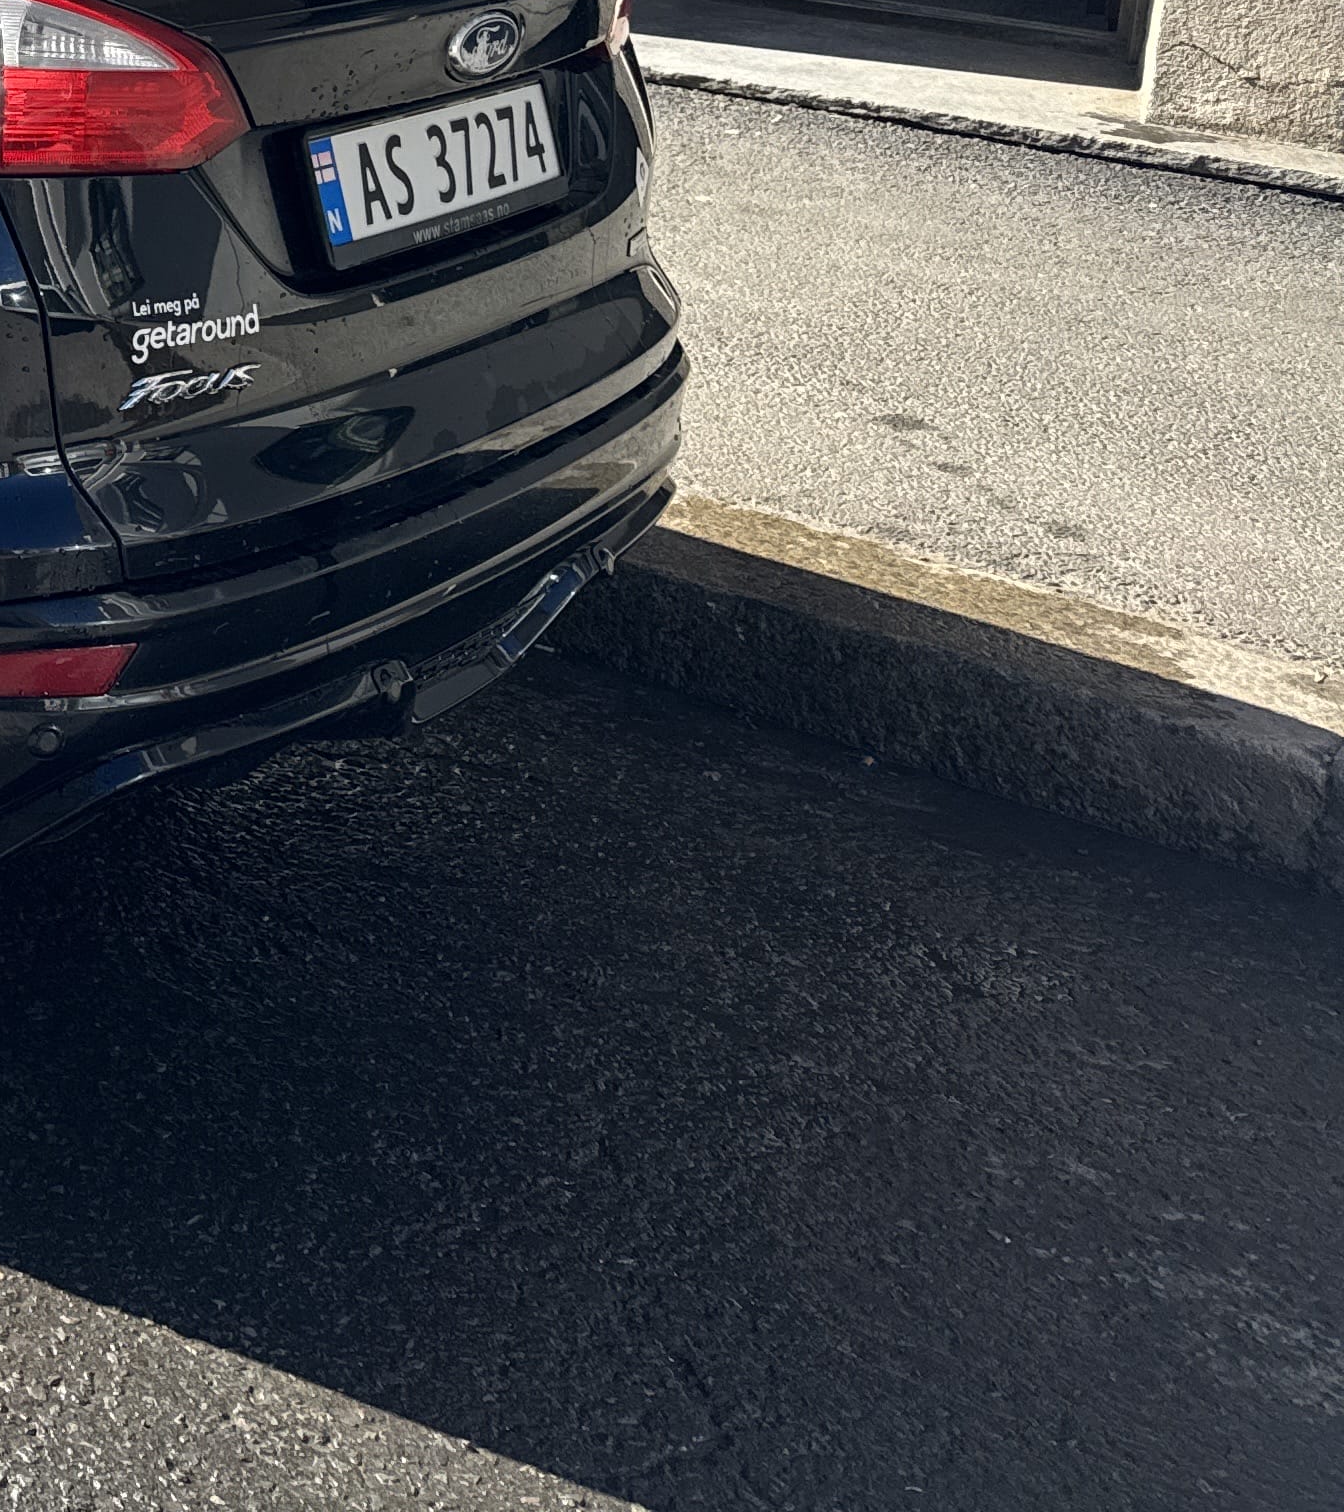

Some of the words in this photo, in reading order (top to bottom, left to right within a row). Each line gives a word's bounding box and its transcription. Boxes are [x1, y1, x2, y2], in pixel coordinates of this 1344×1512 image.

[358, 134, 415, 225] AS
[426, 101, 546, 204] 37274
[326, 208, 343, 234] N
[132, 299, 151, 317] Lei
[153, 300, 182, 316] meg
[183, 292, 200, 315] på
[131, 303, 260, 365] getaround
